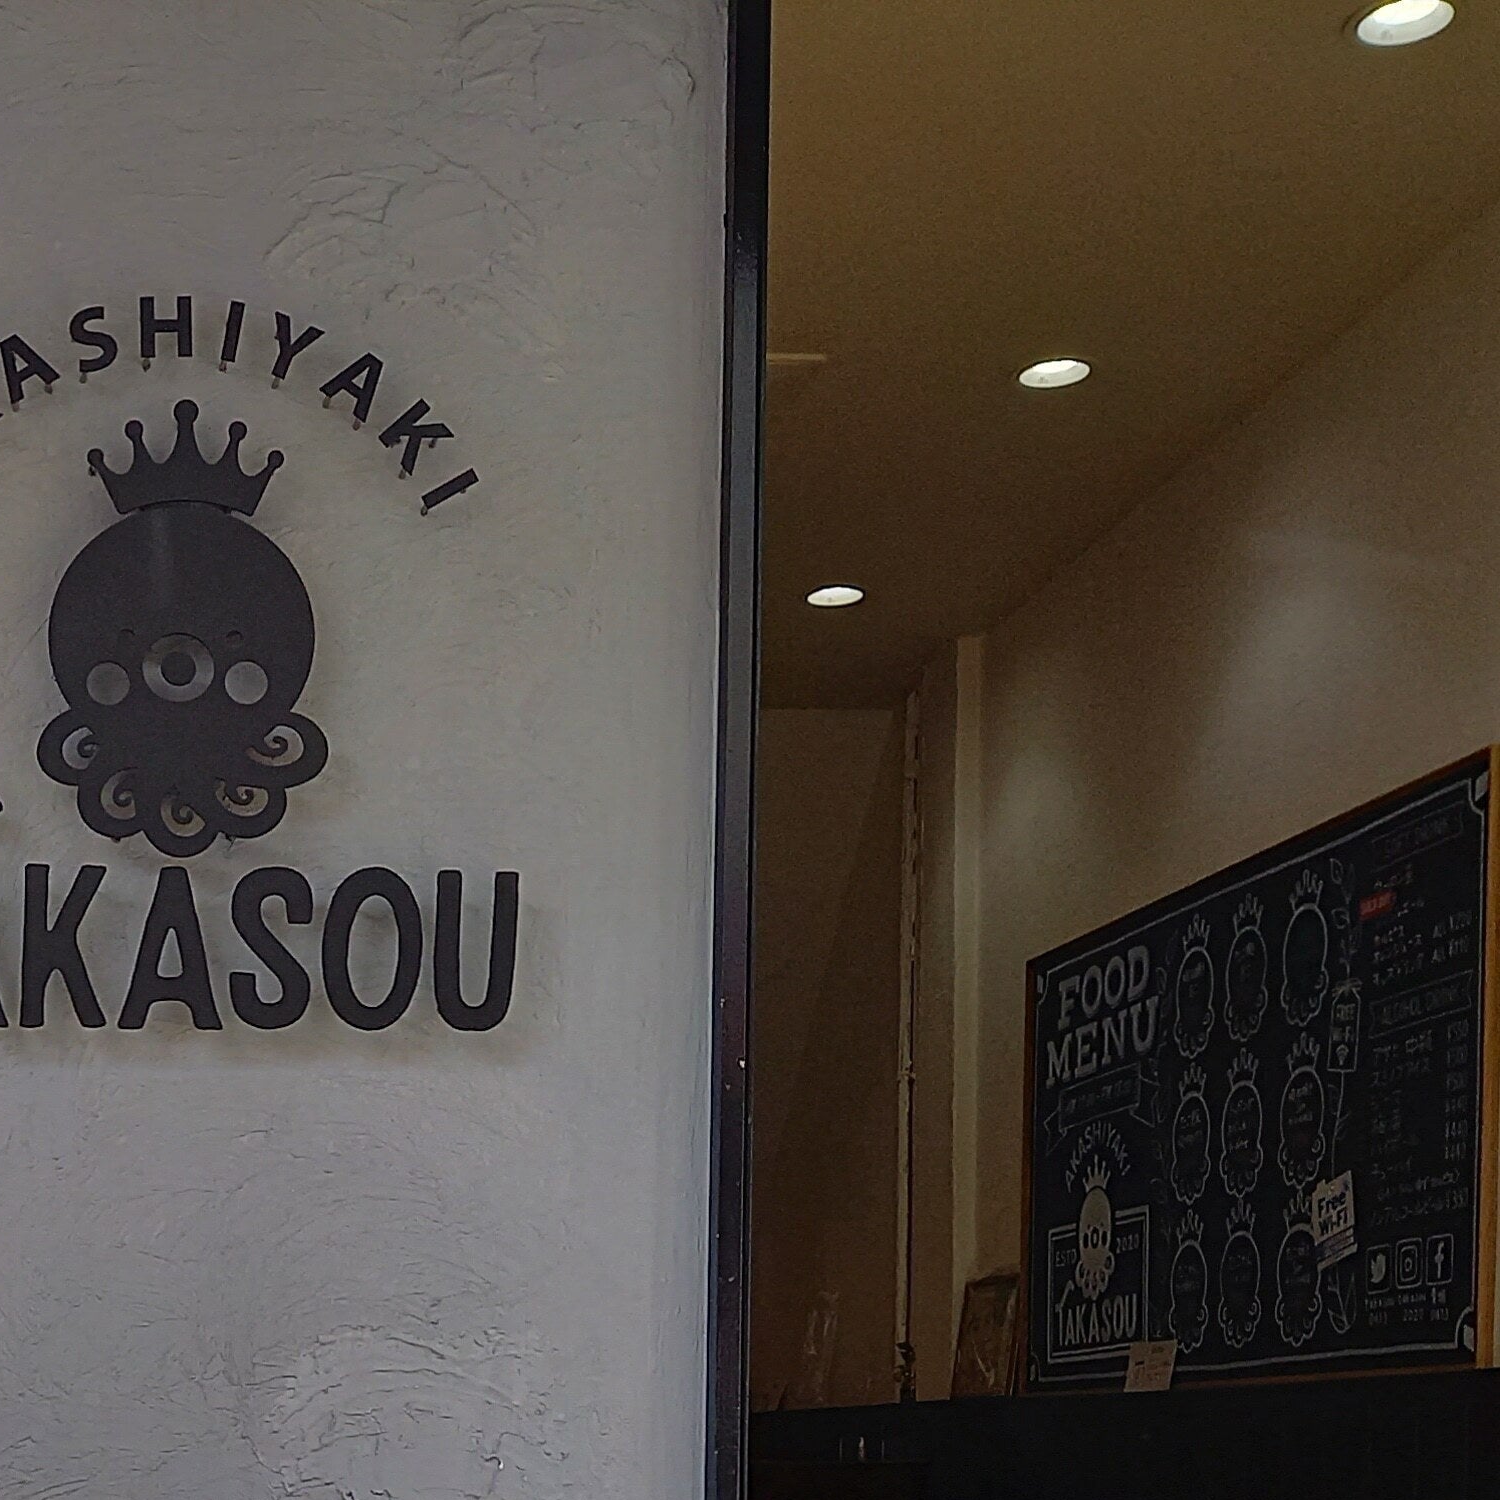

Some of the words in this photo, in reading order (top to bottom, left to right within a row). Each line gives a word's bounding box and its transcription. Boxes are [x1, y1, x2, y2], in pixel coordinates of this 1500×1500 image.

[1058, 945, 1150, 1031] FOOD
[1046, 995, 1159, 1089] MENU
[1064, 1119, 1131, 1193] AKASHIYAKI
[1318, 1191, 1347, 1216] Free
[1054, 1247, 1077, 1268] ESTD
[1115, 1233, 1140, 1254] 2020
[1054, 1279, 1138, 1347] TAKASOU
